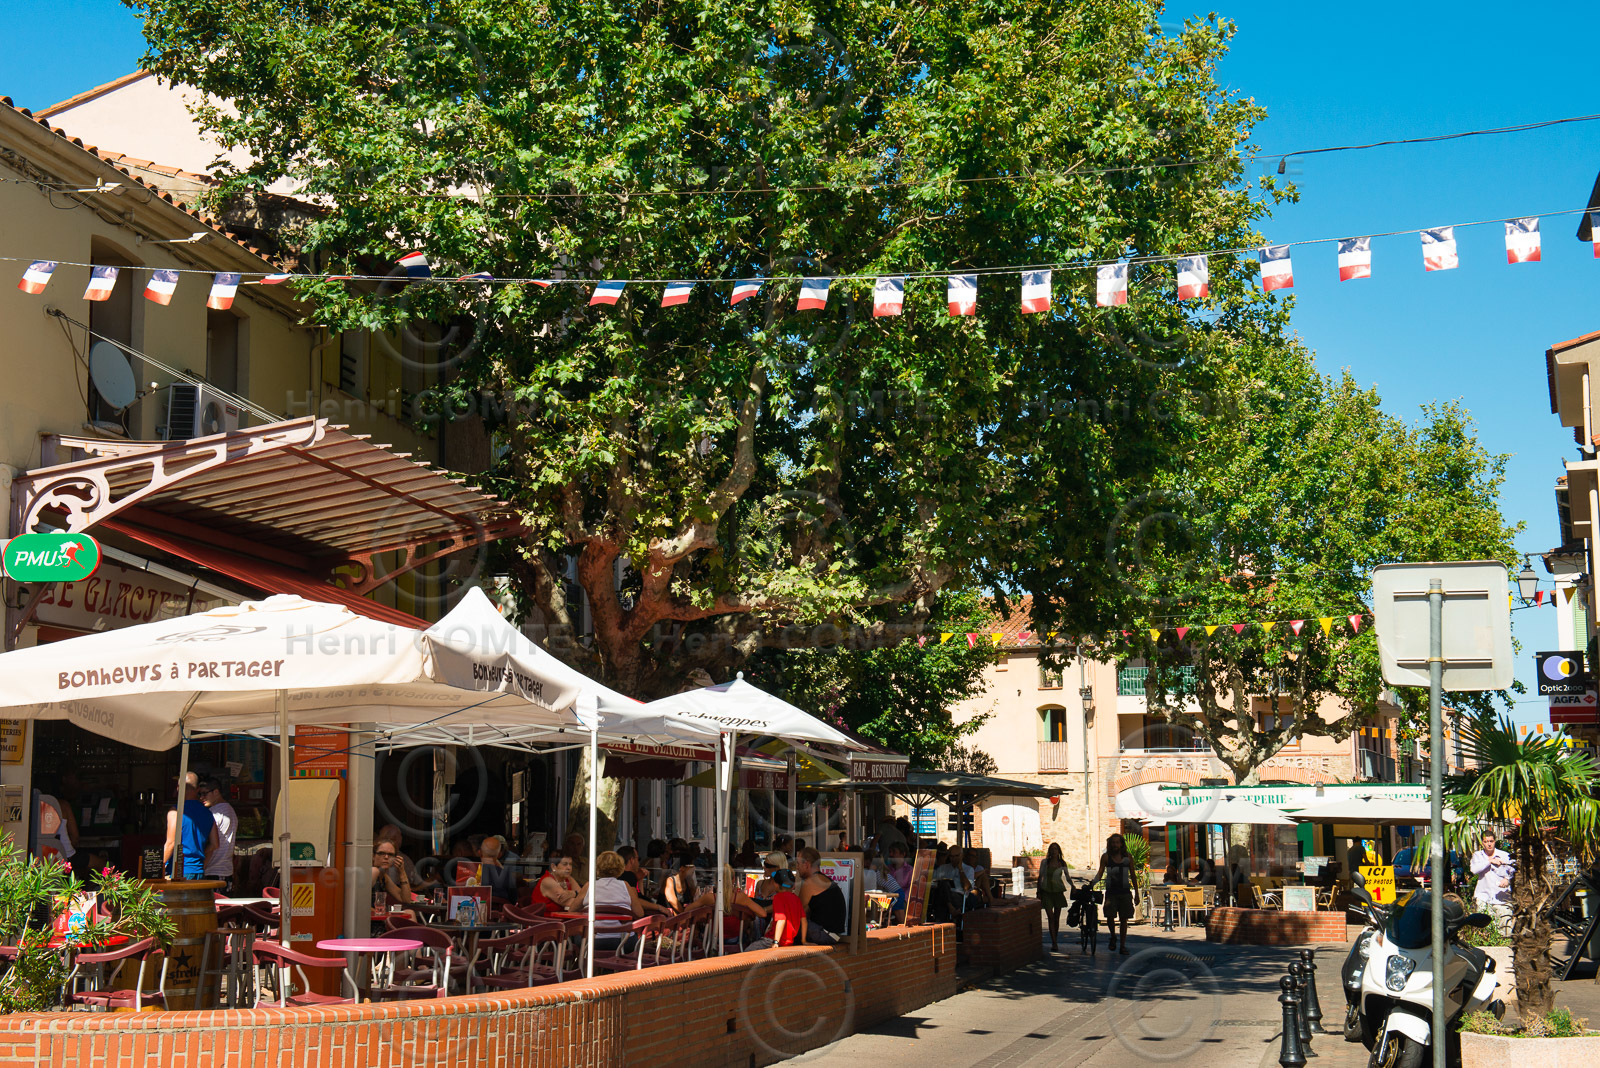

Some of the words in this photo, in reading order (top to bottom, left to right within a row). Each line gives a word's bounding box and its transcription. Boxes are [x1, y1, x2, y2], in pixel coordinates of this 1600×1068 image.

[14, 550, 57, 567] PMU
[170, 662, 180, 680] à
[1540, 684, 1563, 694] Optic
[1553, 695, 1582, 704] AGFA
[678, 711, 772, 728] hweppes
[853, 762, 867, 777] BAR
[871, 764, 907, 779] RESTAURANT
[1367, 867, 1386, 876] ICI
